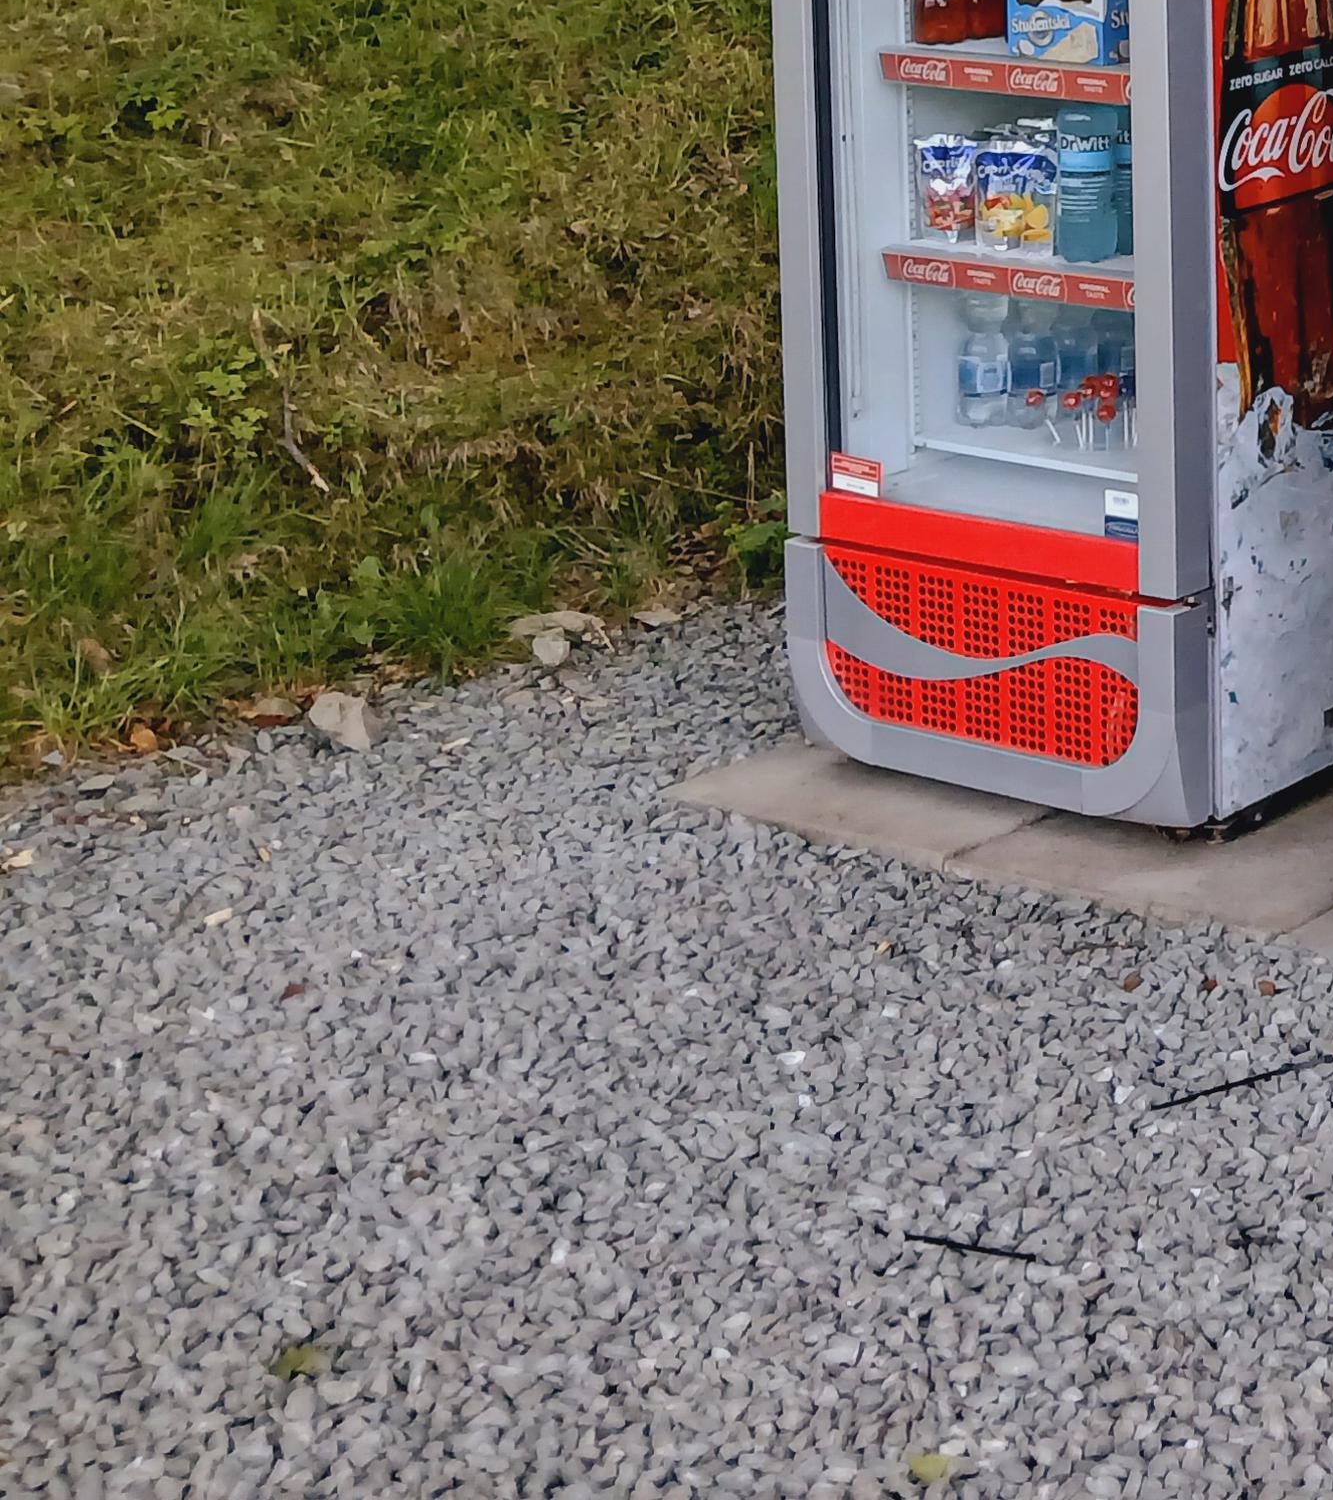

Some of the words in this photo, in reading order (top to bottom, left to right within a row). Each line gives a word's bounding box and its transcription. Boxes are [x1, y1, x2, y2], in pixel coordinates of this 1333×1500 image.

[1229, 75, 1253, 91] zero
[1253, 67, 1284, 85] SUGAR
[1289, 60, 1314, 76] zero
